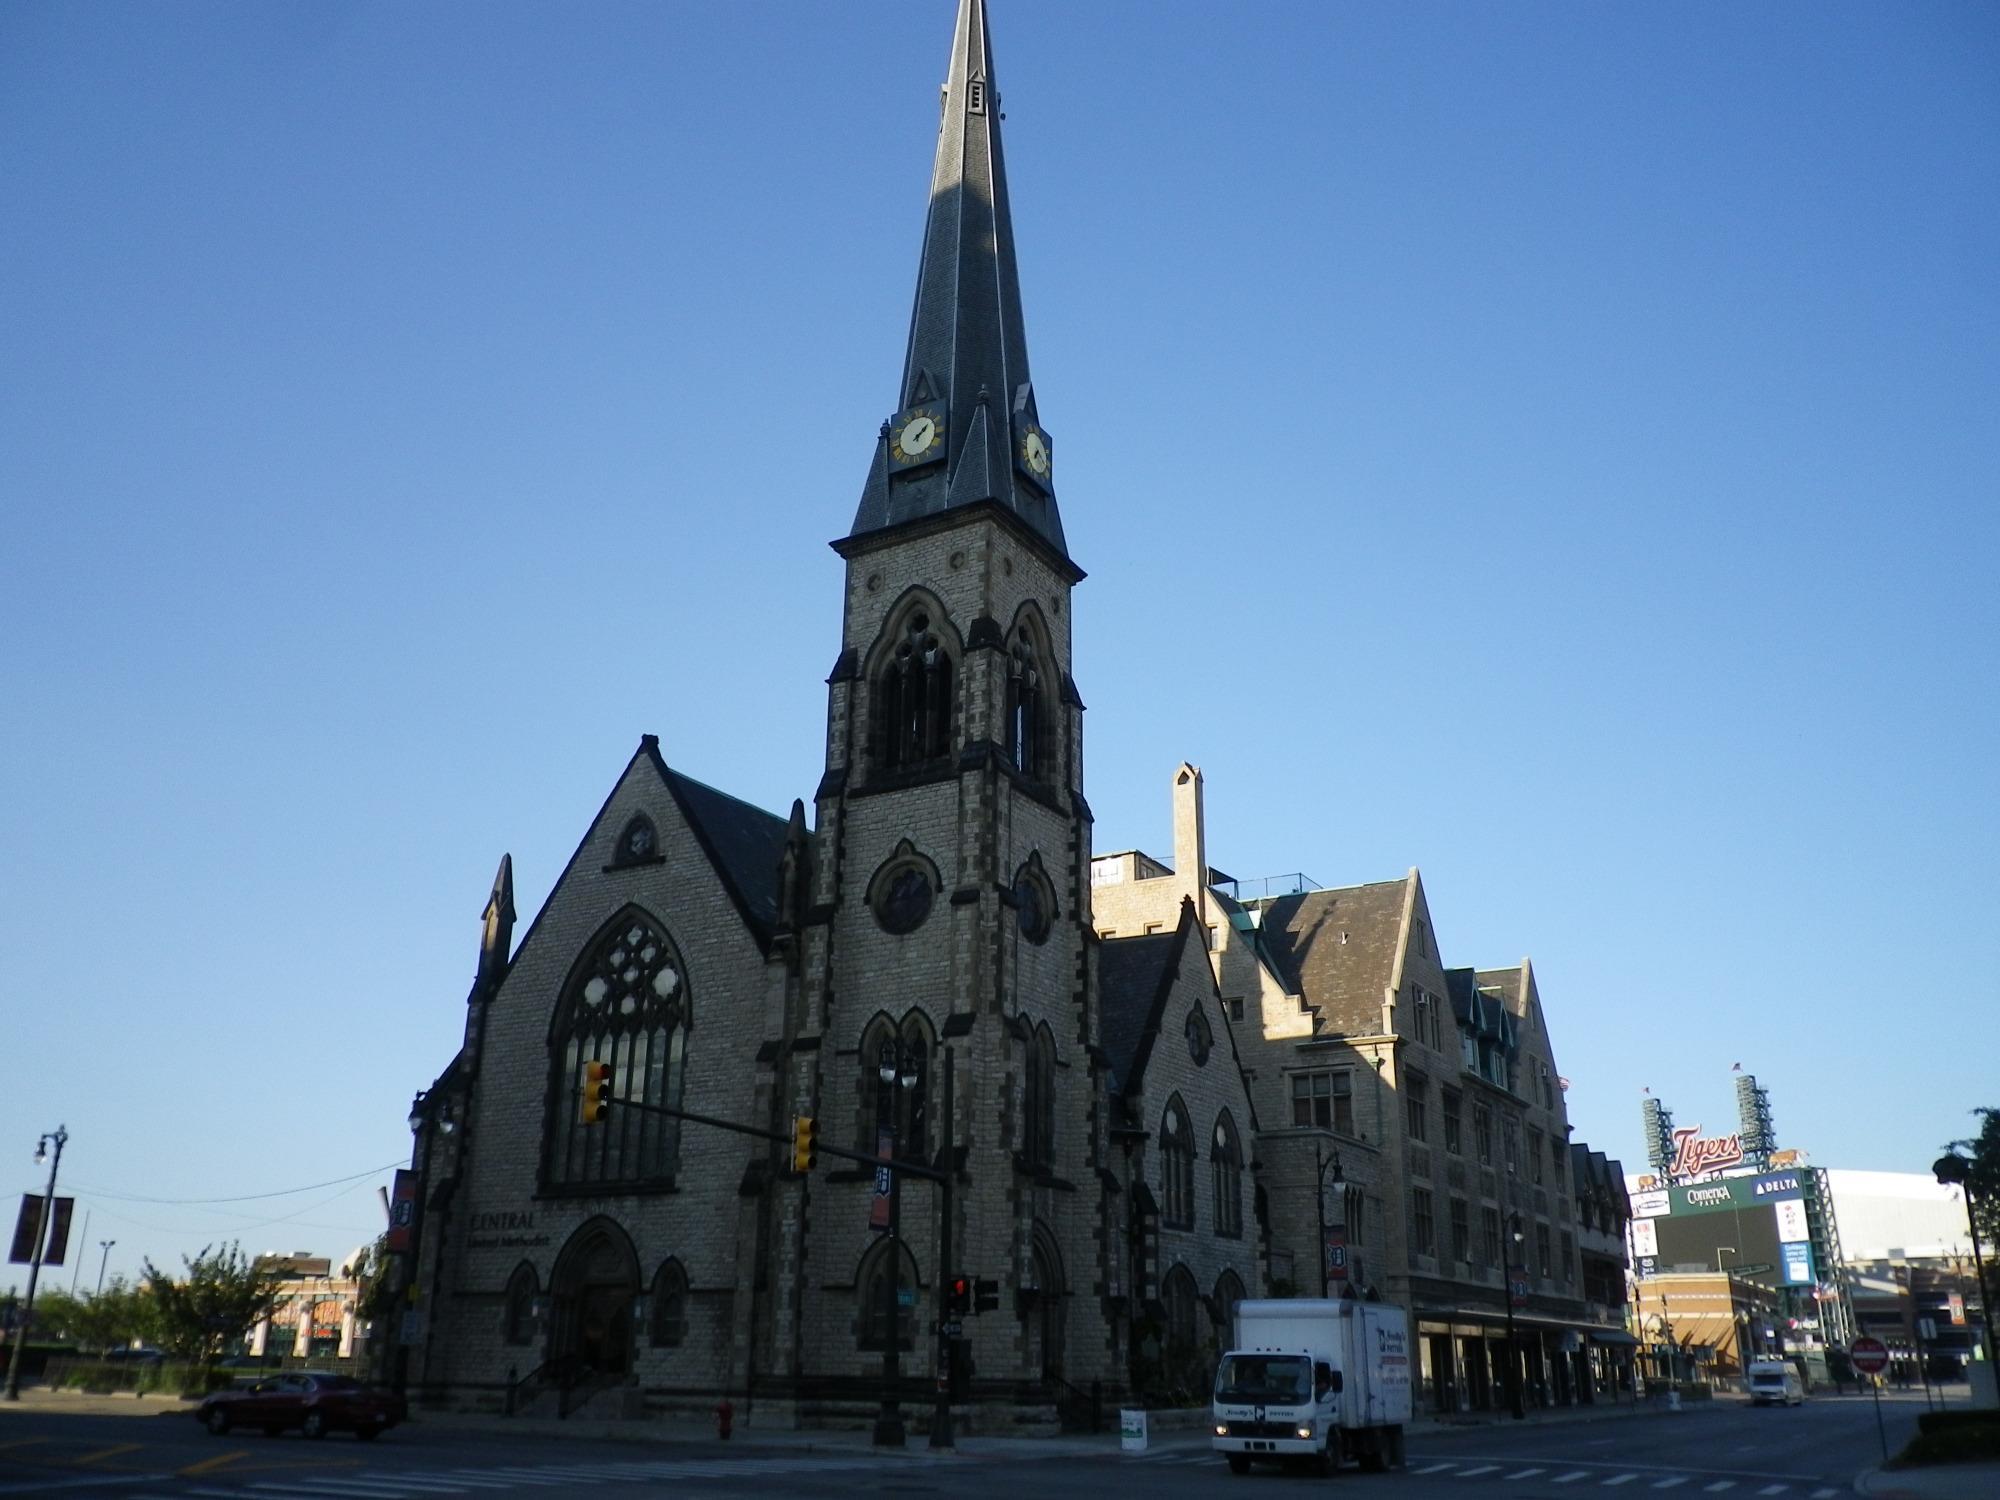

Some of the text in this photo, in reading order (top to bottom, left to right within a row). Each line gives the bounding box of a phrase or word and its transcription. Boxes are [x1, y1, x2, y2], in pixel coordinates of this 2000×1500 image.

[1670, 1125, 1743, 1179] Tigers
[1766, 1178, 1798, 1192] DELTA
[1699, 1199, 1720, 1208] PARK
[470, 1212, 533, 1230] CENTRAL
